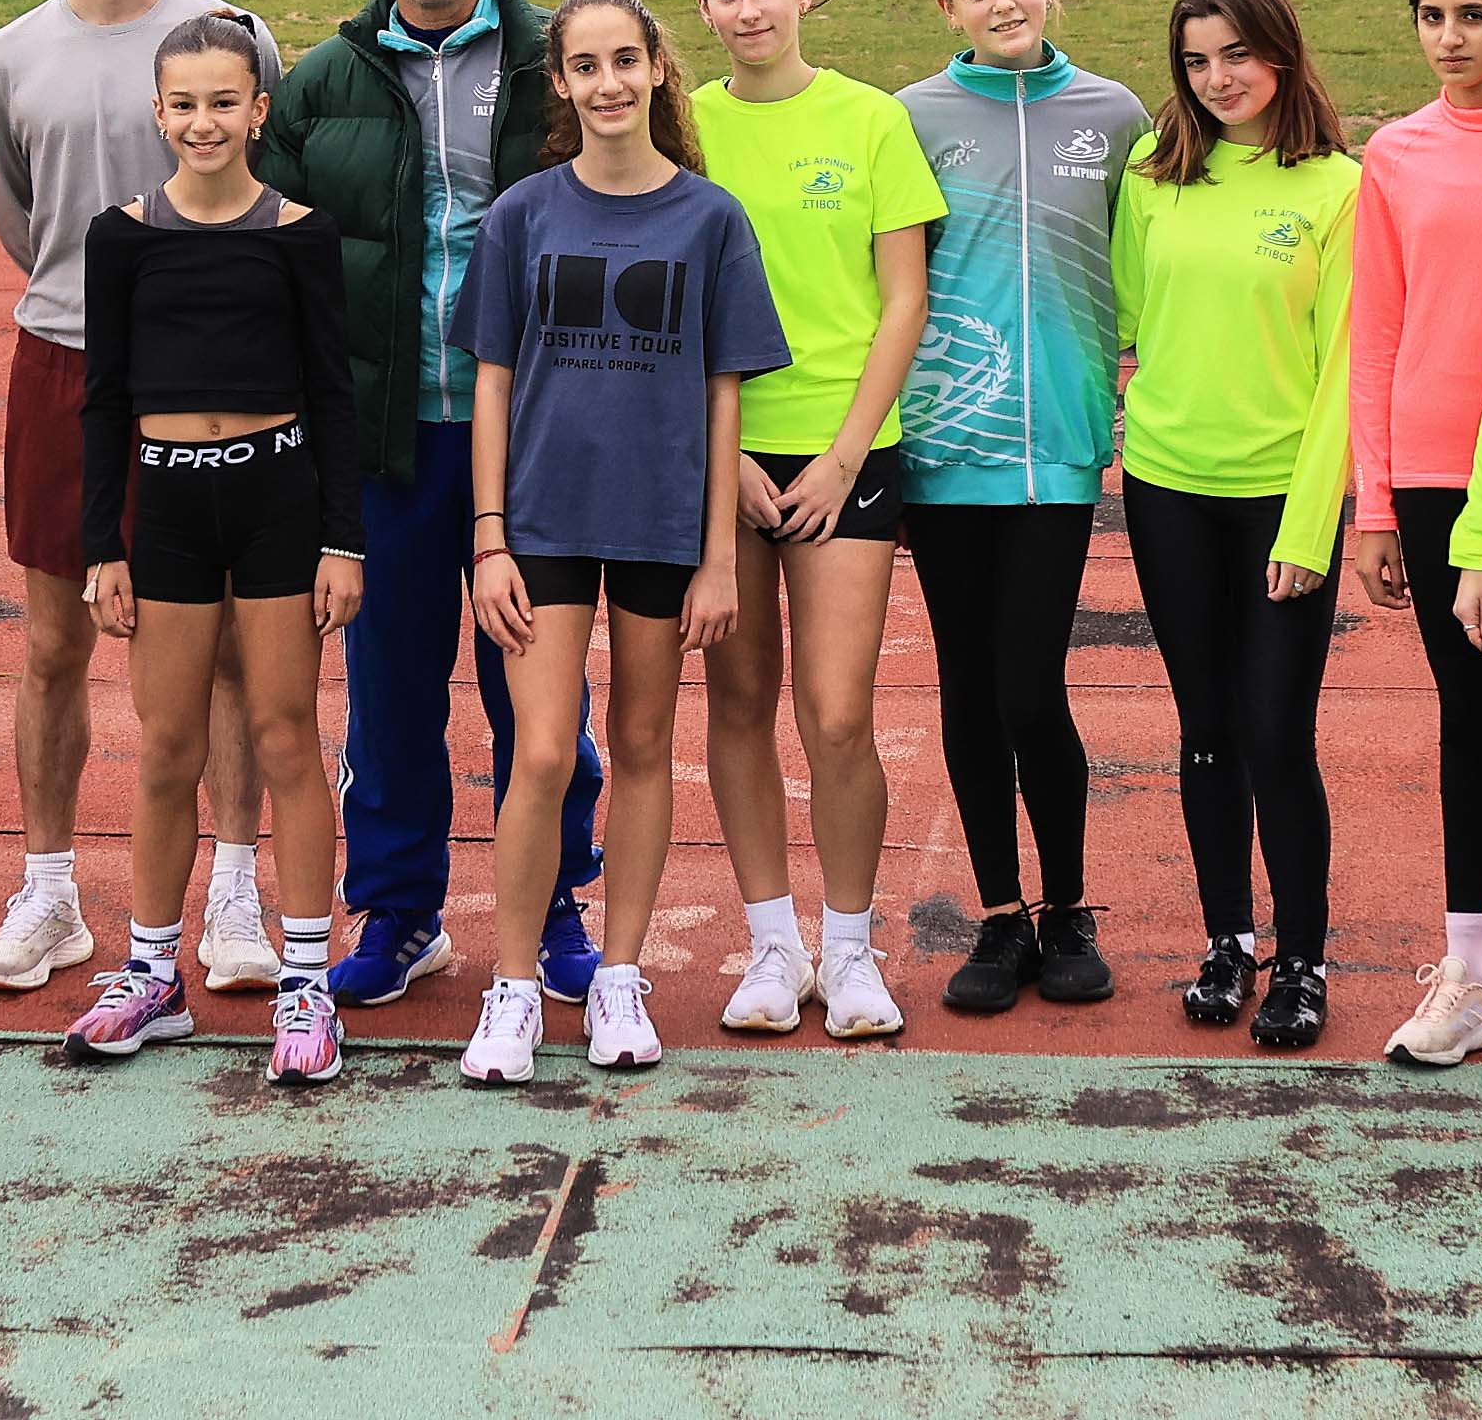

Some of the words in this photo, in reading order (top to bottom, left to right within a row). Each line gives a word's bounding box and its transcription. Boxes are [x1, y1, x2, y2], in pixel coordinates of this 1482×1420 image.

[802, 199, 842, 210] ΣΤΙΒΟΣ
[1255, 245, 1295, 265] ΣΤΙΒΟΣ
[630, 335, 682, 355] TOUR
[553, 357, 604, 370] APPAREL
[608, 359, 656, 373] DROP#2
[167, 442, 255, 469] PRO
